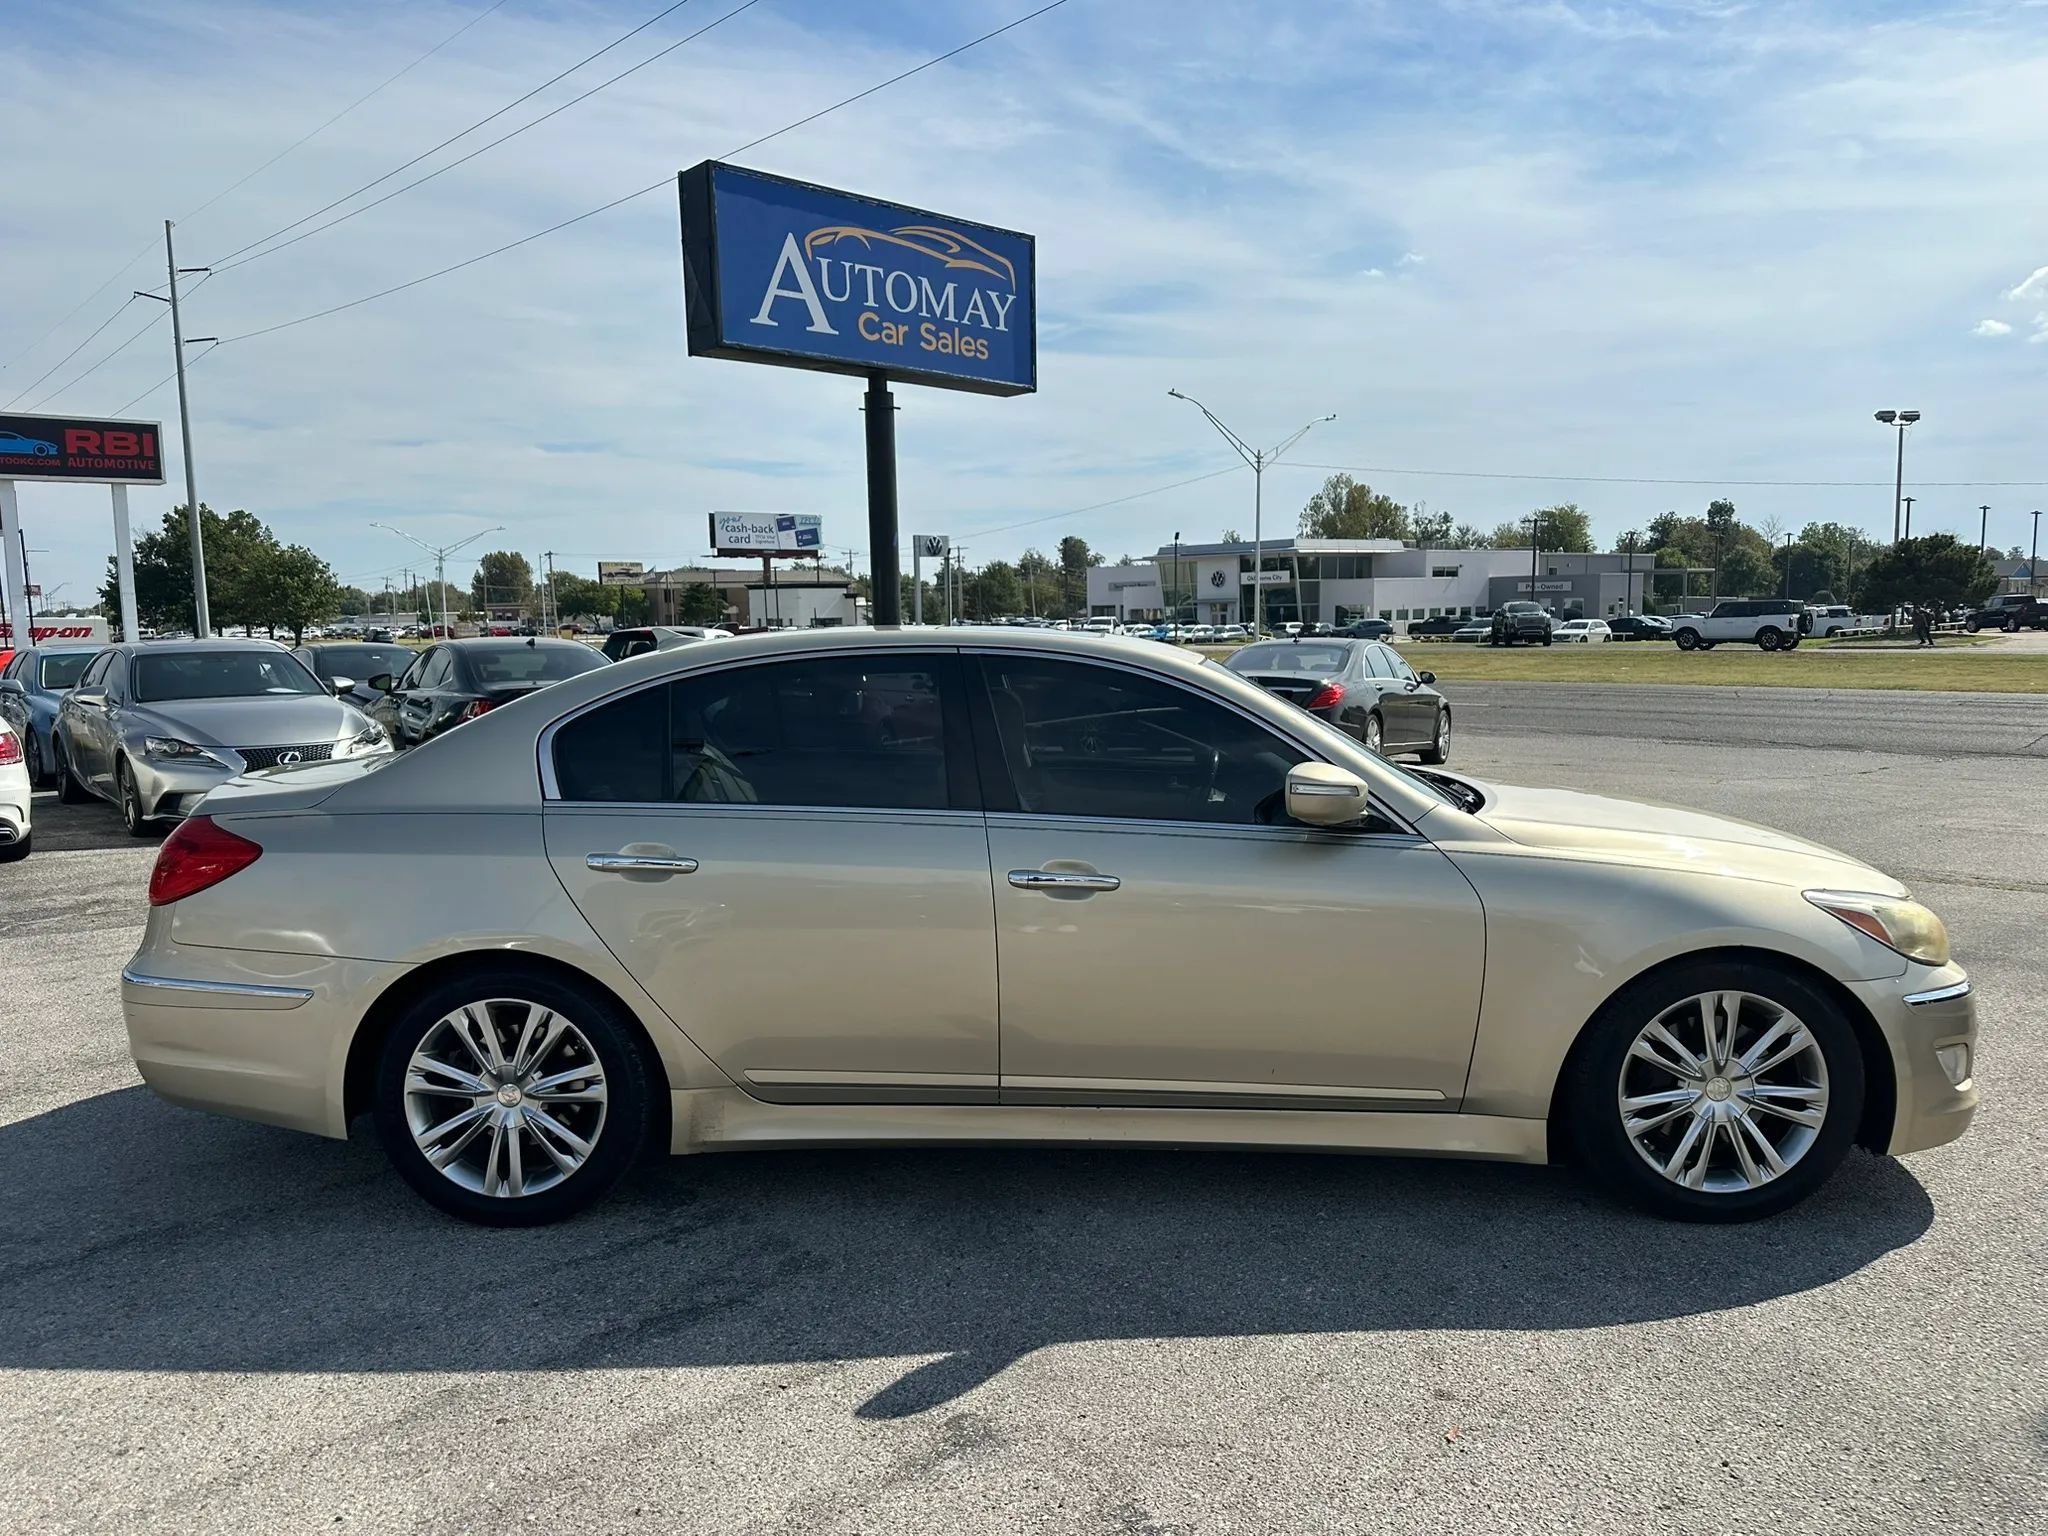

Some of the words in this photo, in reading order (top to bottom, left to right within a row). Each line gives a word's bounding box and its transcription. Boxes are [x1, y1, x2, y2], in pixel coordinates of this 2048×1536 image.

[858, 312, 909, 346] Car
[920, 322, 989, 361] Sales
[64, 428, 155, 457] RBI
[67, 457, 156, 470] AUTOMOTIVE
[725, 523, 774, 534] cash-back
[728, 534, 751, 544] card
[1272, 574, 1282, 582] City
